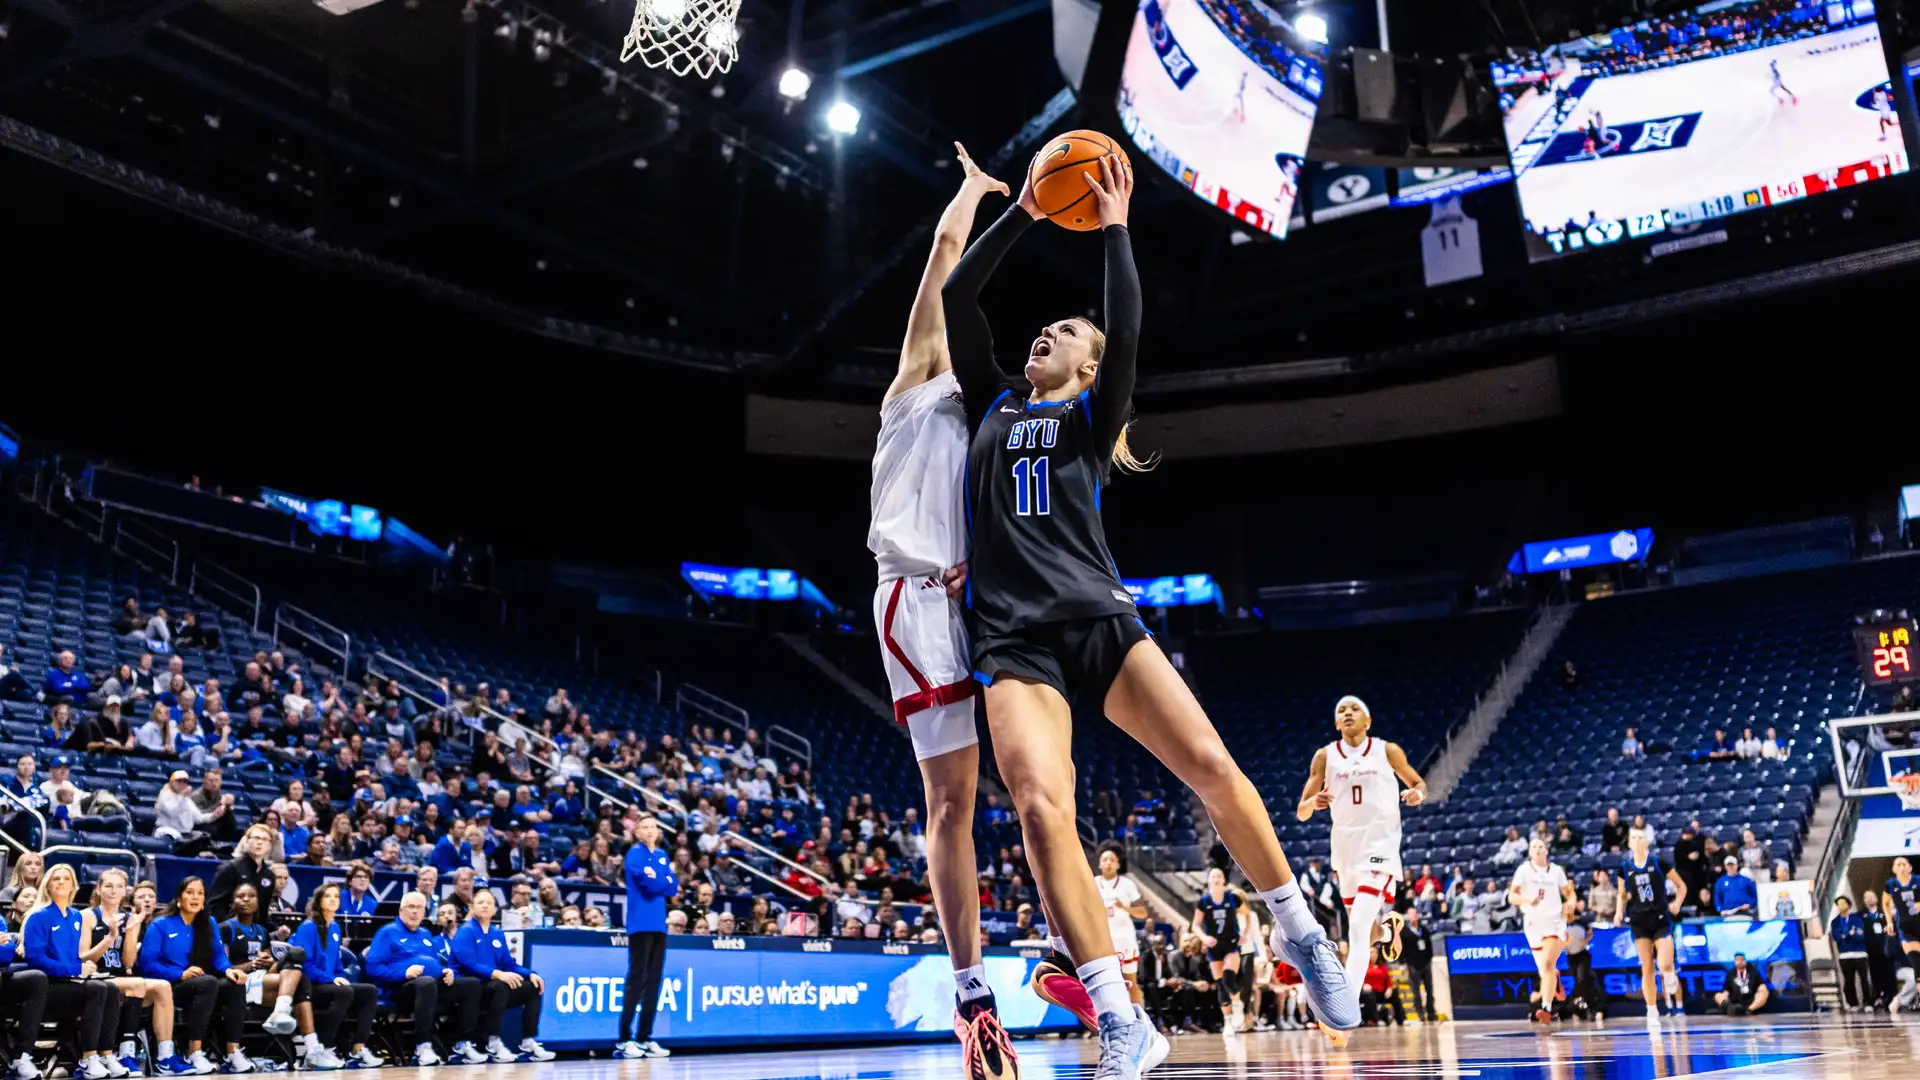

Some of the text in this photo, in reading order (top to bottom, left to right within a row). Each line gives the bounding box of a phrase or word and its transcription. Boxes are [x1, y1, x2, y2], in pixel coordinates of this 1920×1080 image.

[1636, 214, 1656, 231] 72
[1439, 227, 1460, 251] 11
[1007, 418, 1060, 449] BYU
[1012, 456, 1050, 516] 11
[1879, 627, 1910, 648] 1:19
[1873, 646, 1911, 678] 29
[1352, 785, 1362, 805] 0
[103, 949, 122, 968] 13
[702, 984, 764, 1012] pursue
[767, 980, 817, 1005] what's
[1482, 977, 1534, 999] BY
